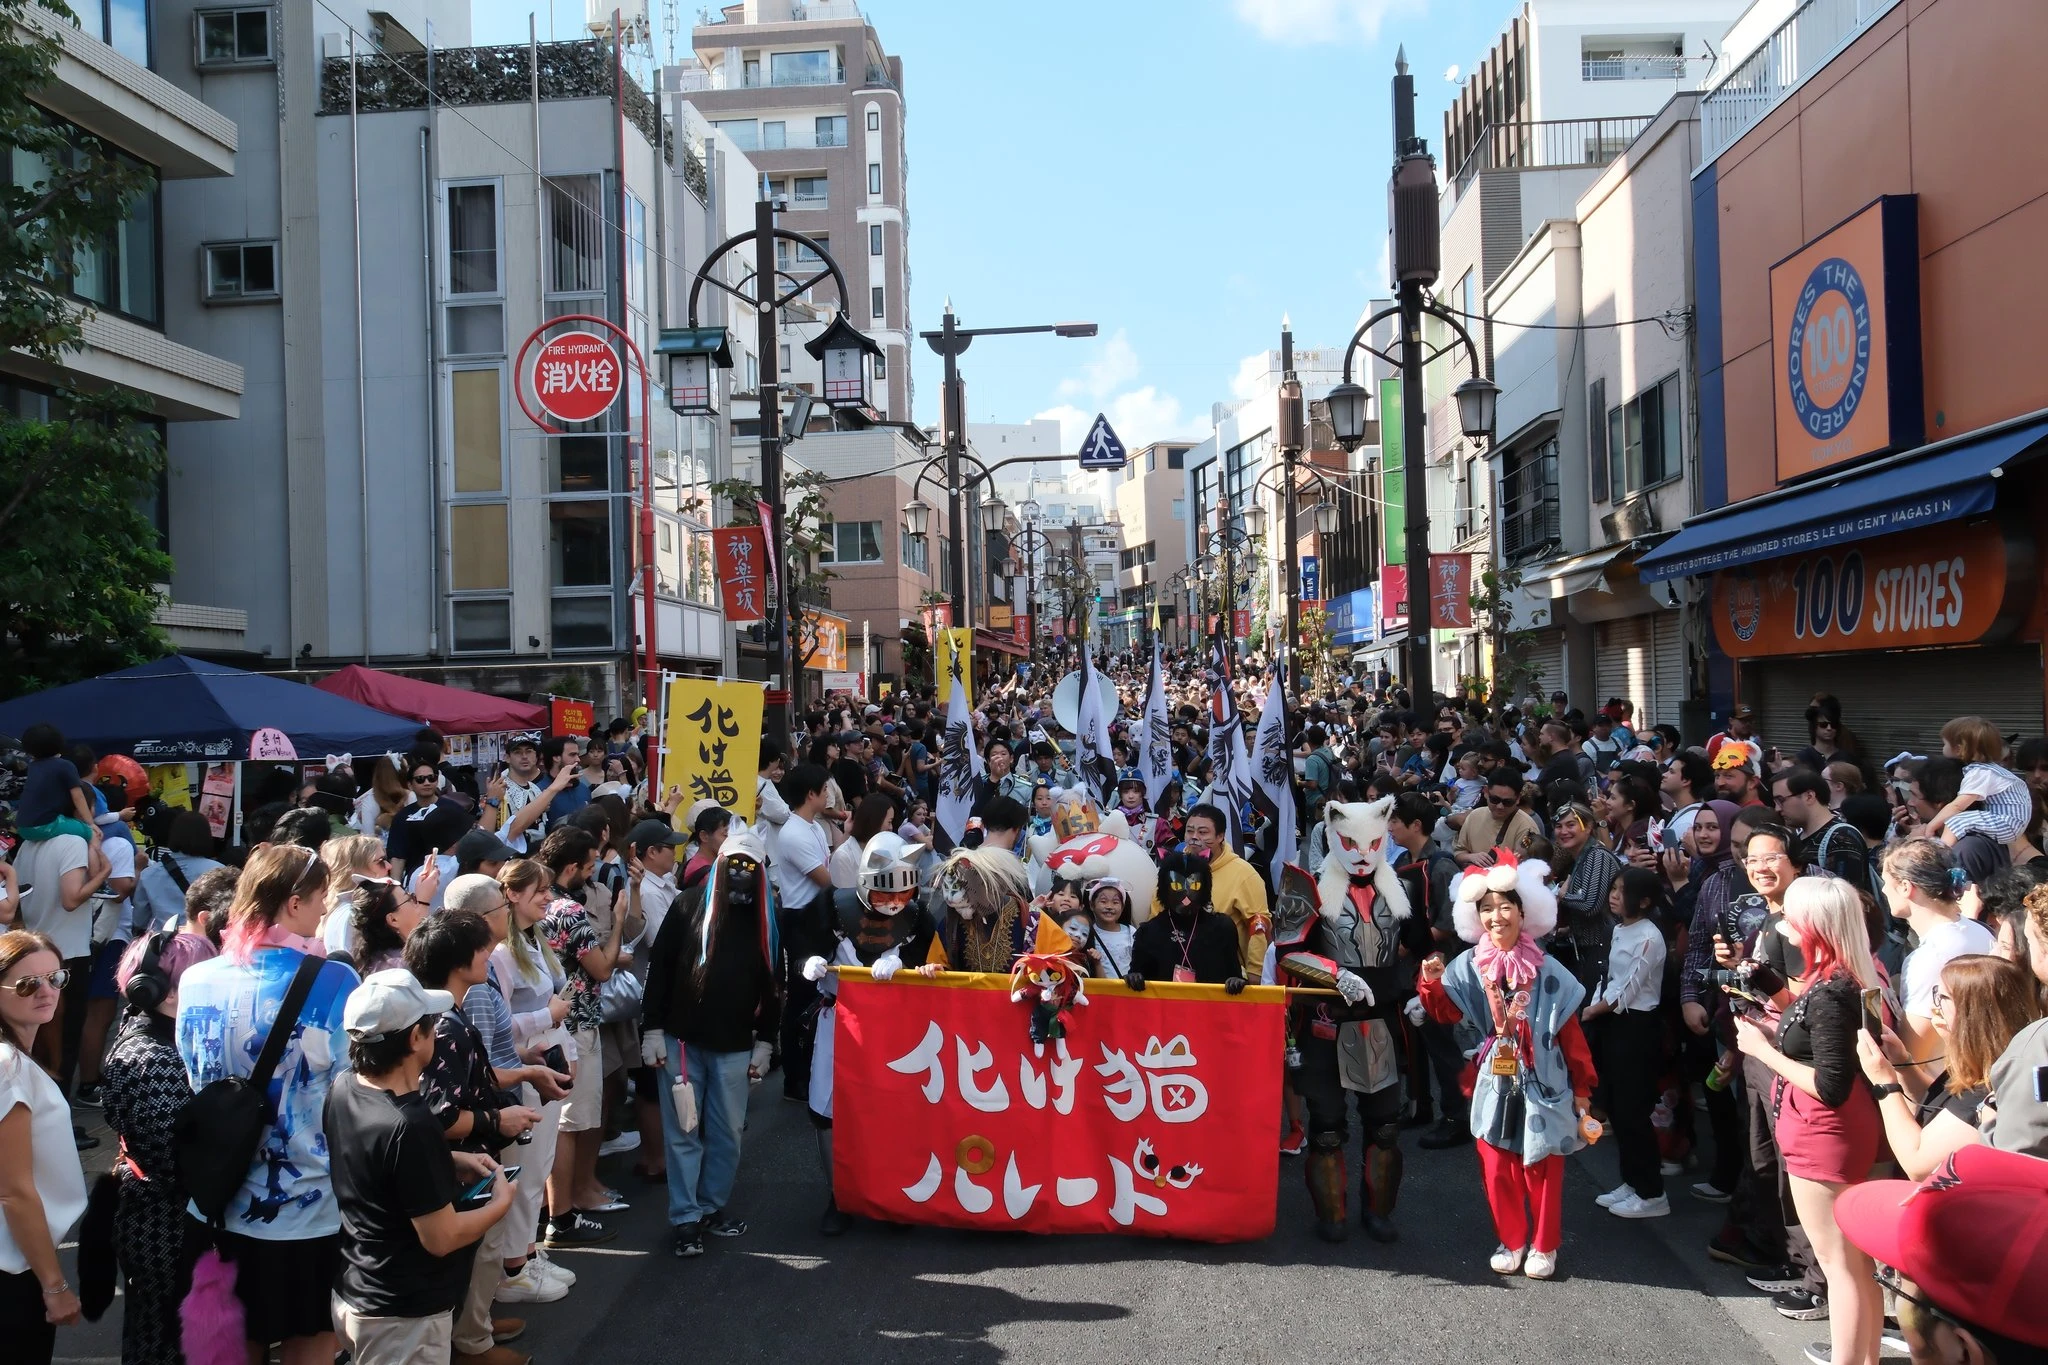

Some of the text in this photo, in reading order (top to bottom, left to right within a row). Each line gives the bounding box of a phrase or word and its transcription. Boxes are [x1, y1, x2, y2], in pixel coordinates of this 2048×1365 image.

[542, 358, 614, 394] 消火栓
[548, 343, 604, 355] FIRE HYDRANT
[1791, 265, 1868, 433] THE HUNDRED STORES
[1806, 305, 1850, 378] 100
[725, 535, 759, 615] 神楽坂
[1667, 561, 1687, 573] CENTO
[1689, 554, 1722, 569] BOTTEGE
[1724, 551, 1739, 561] THE
[1741, 540, 1779, 557] HUNDRED
[1782, 530, 1819, 548] STORES
[1822, 526, 1835, 538] LE
[1839, 522, 1853, 534] UN
[1857, 514, 1887, 530] CENT
[1891, 499, 1951, 523] MAGASIN
[1433, 559, 1463, 625] 神楽坂
[1793, 549, 1864, 640] 100
[1873, 556, 1965, 634] STORES
[686, 697, 740, 806] 化け猫
[886, 1020, 1208, 1123] 化け猫
[901, 1134, 1204, 1225] パレード
